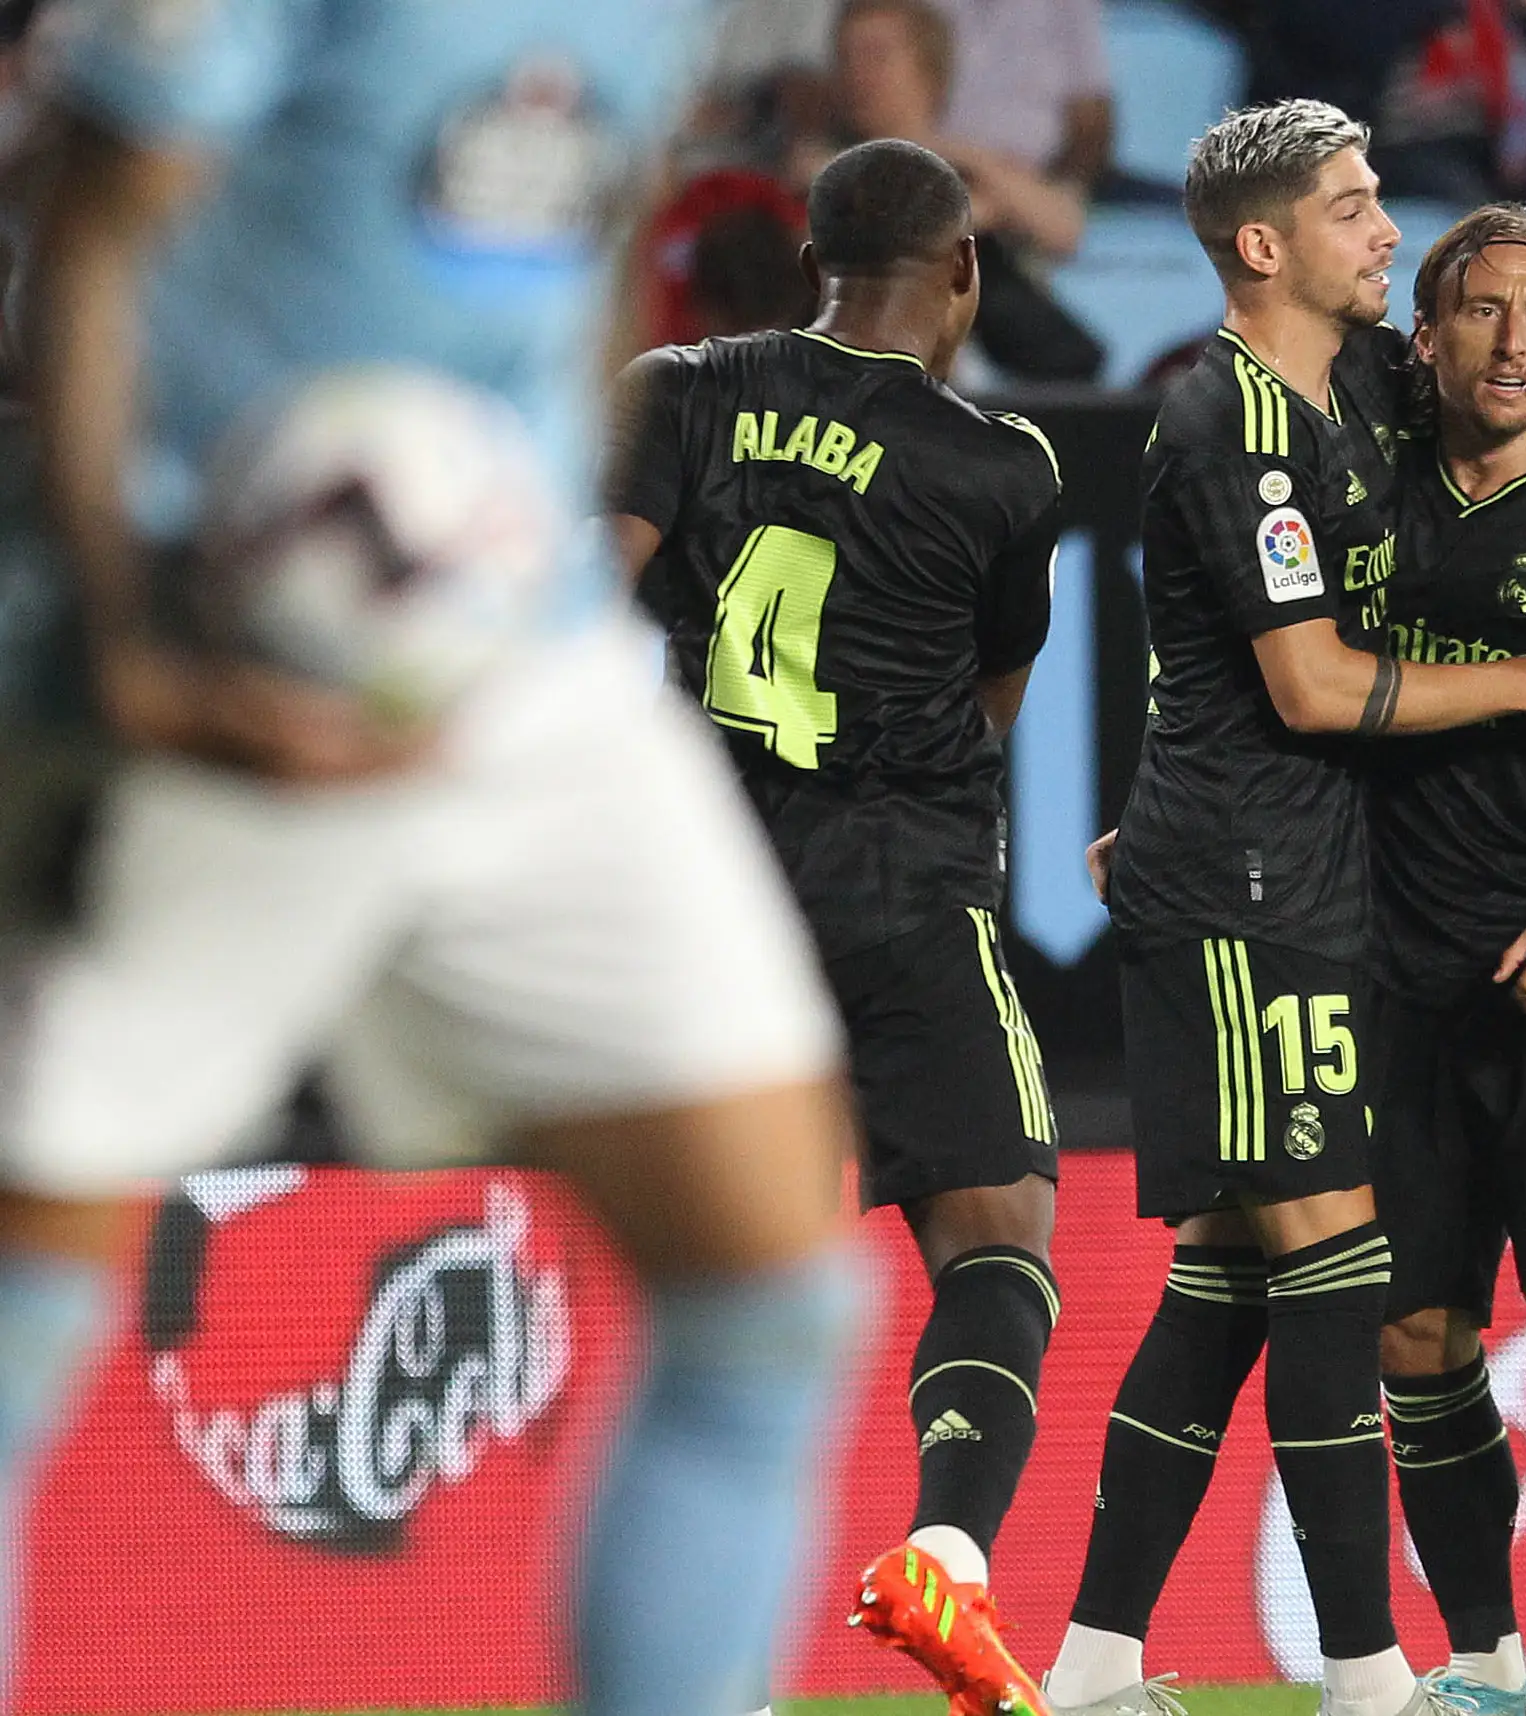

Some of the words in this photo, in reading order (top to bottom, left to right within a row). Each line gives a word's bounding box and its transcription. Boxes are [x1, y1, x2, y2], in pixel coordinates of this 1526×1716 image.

[733, 410, 885, 495] ALABA
[1272, 572, 1318, 589] LaLiga
[703, 525, 837, 769] 4
[1263, 993, 1358, 1094] 15
